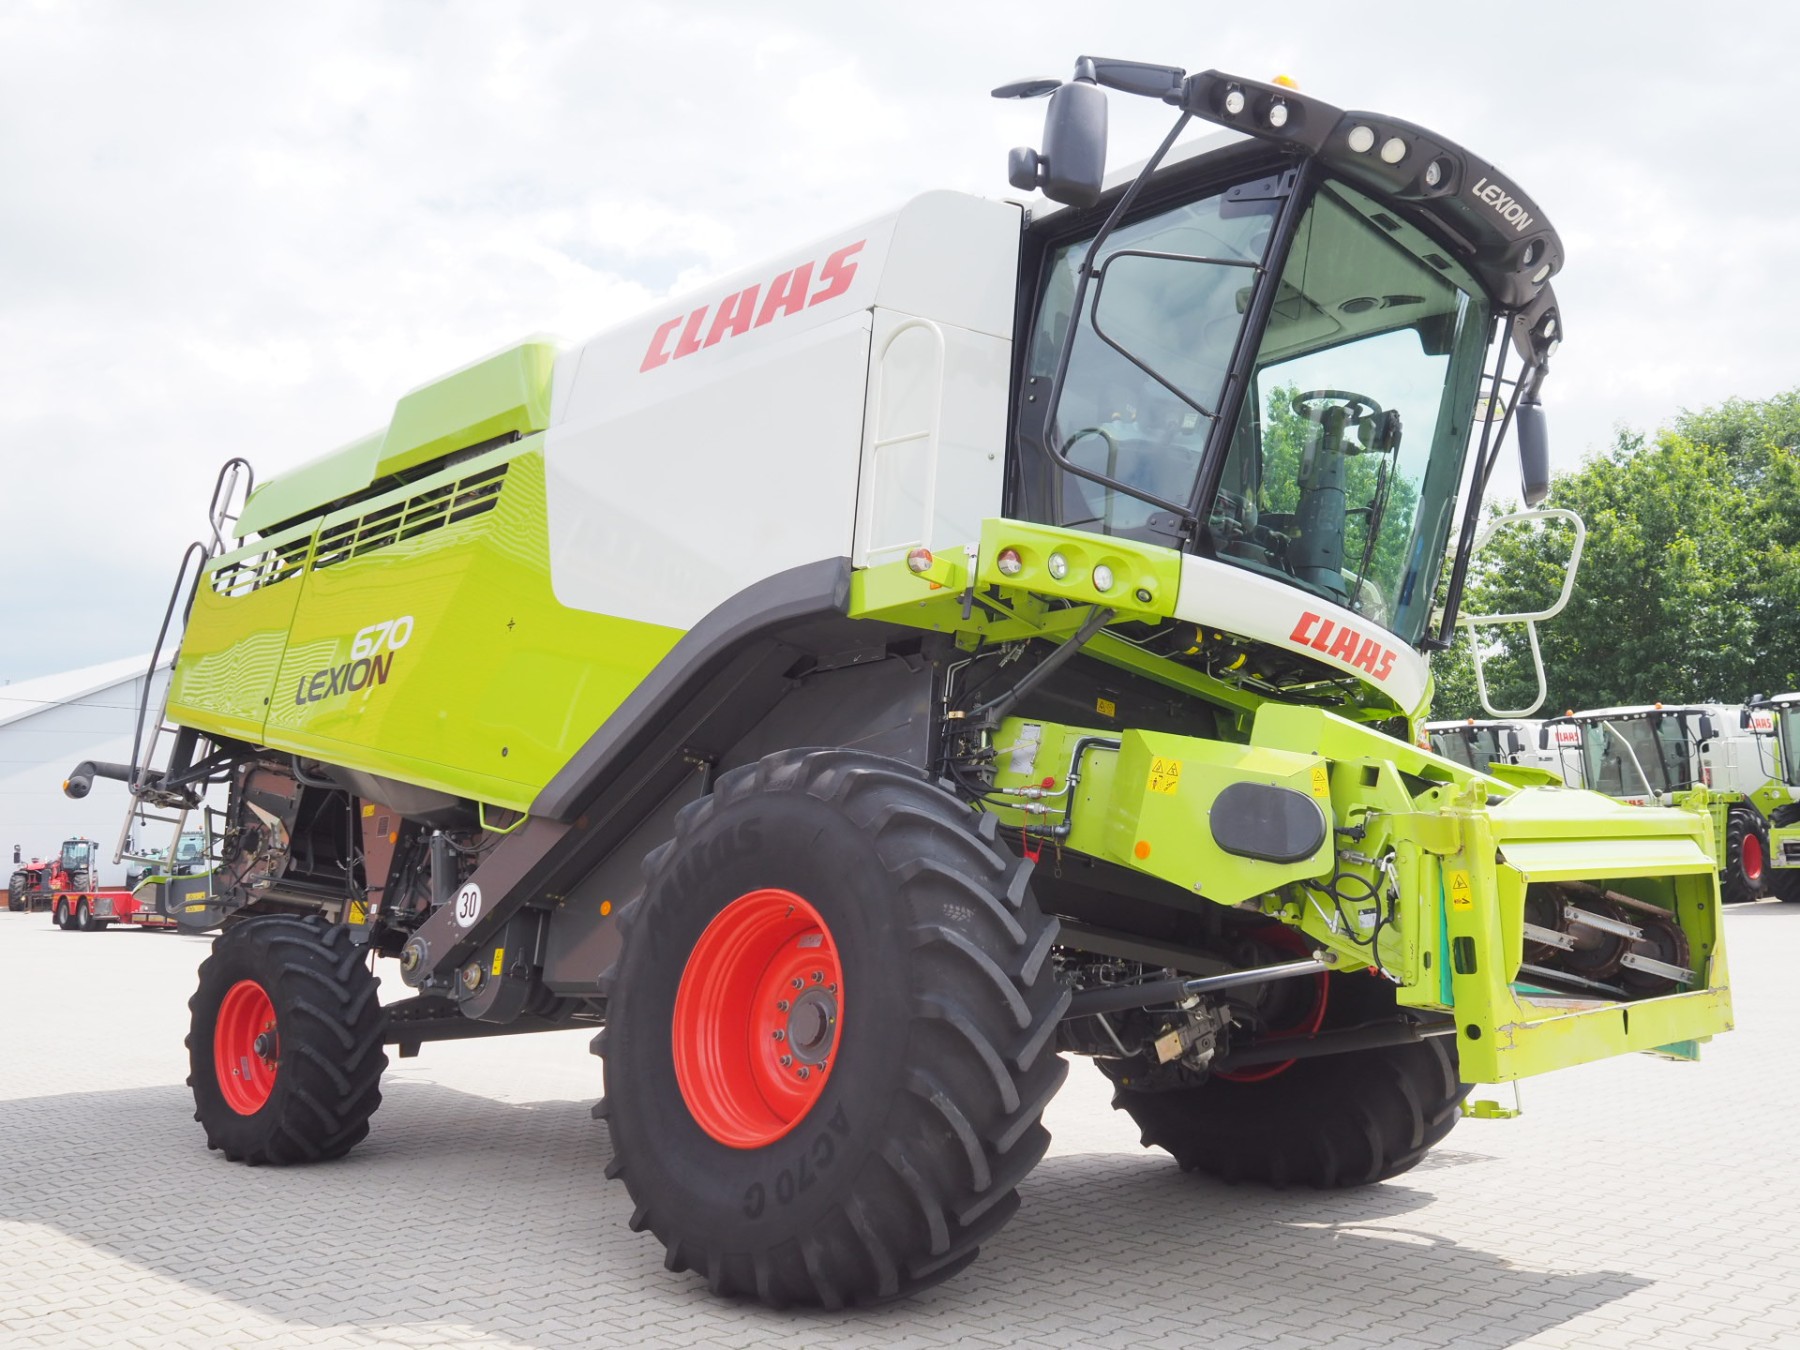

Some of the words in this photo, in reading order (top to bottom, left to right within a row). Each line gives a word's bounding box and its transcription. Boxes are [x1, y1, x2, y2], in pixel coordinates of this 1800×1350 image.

[1472, 177, 1534, 232] LEXION
[639, 239, 867, 373] CLAAS
[350, 615, 414, 661] 670
[1289, 611, 1397, 681] CLAAS
[295, 651, 394, 706] LEXION
[1746, 718, 1772, 728] AAS
[459, 891, 477, 919] 30
